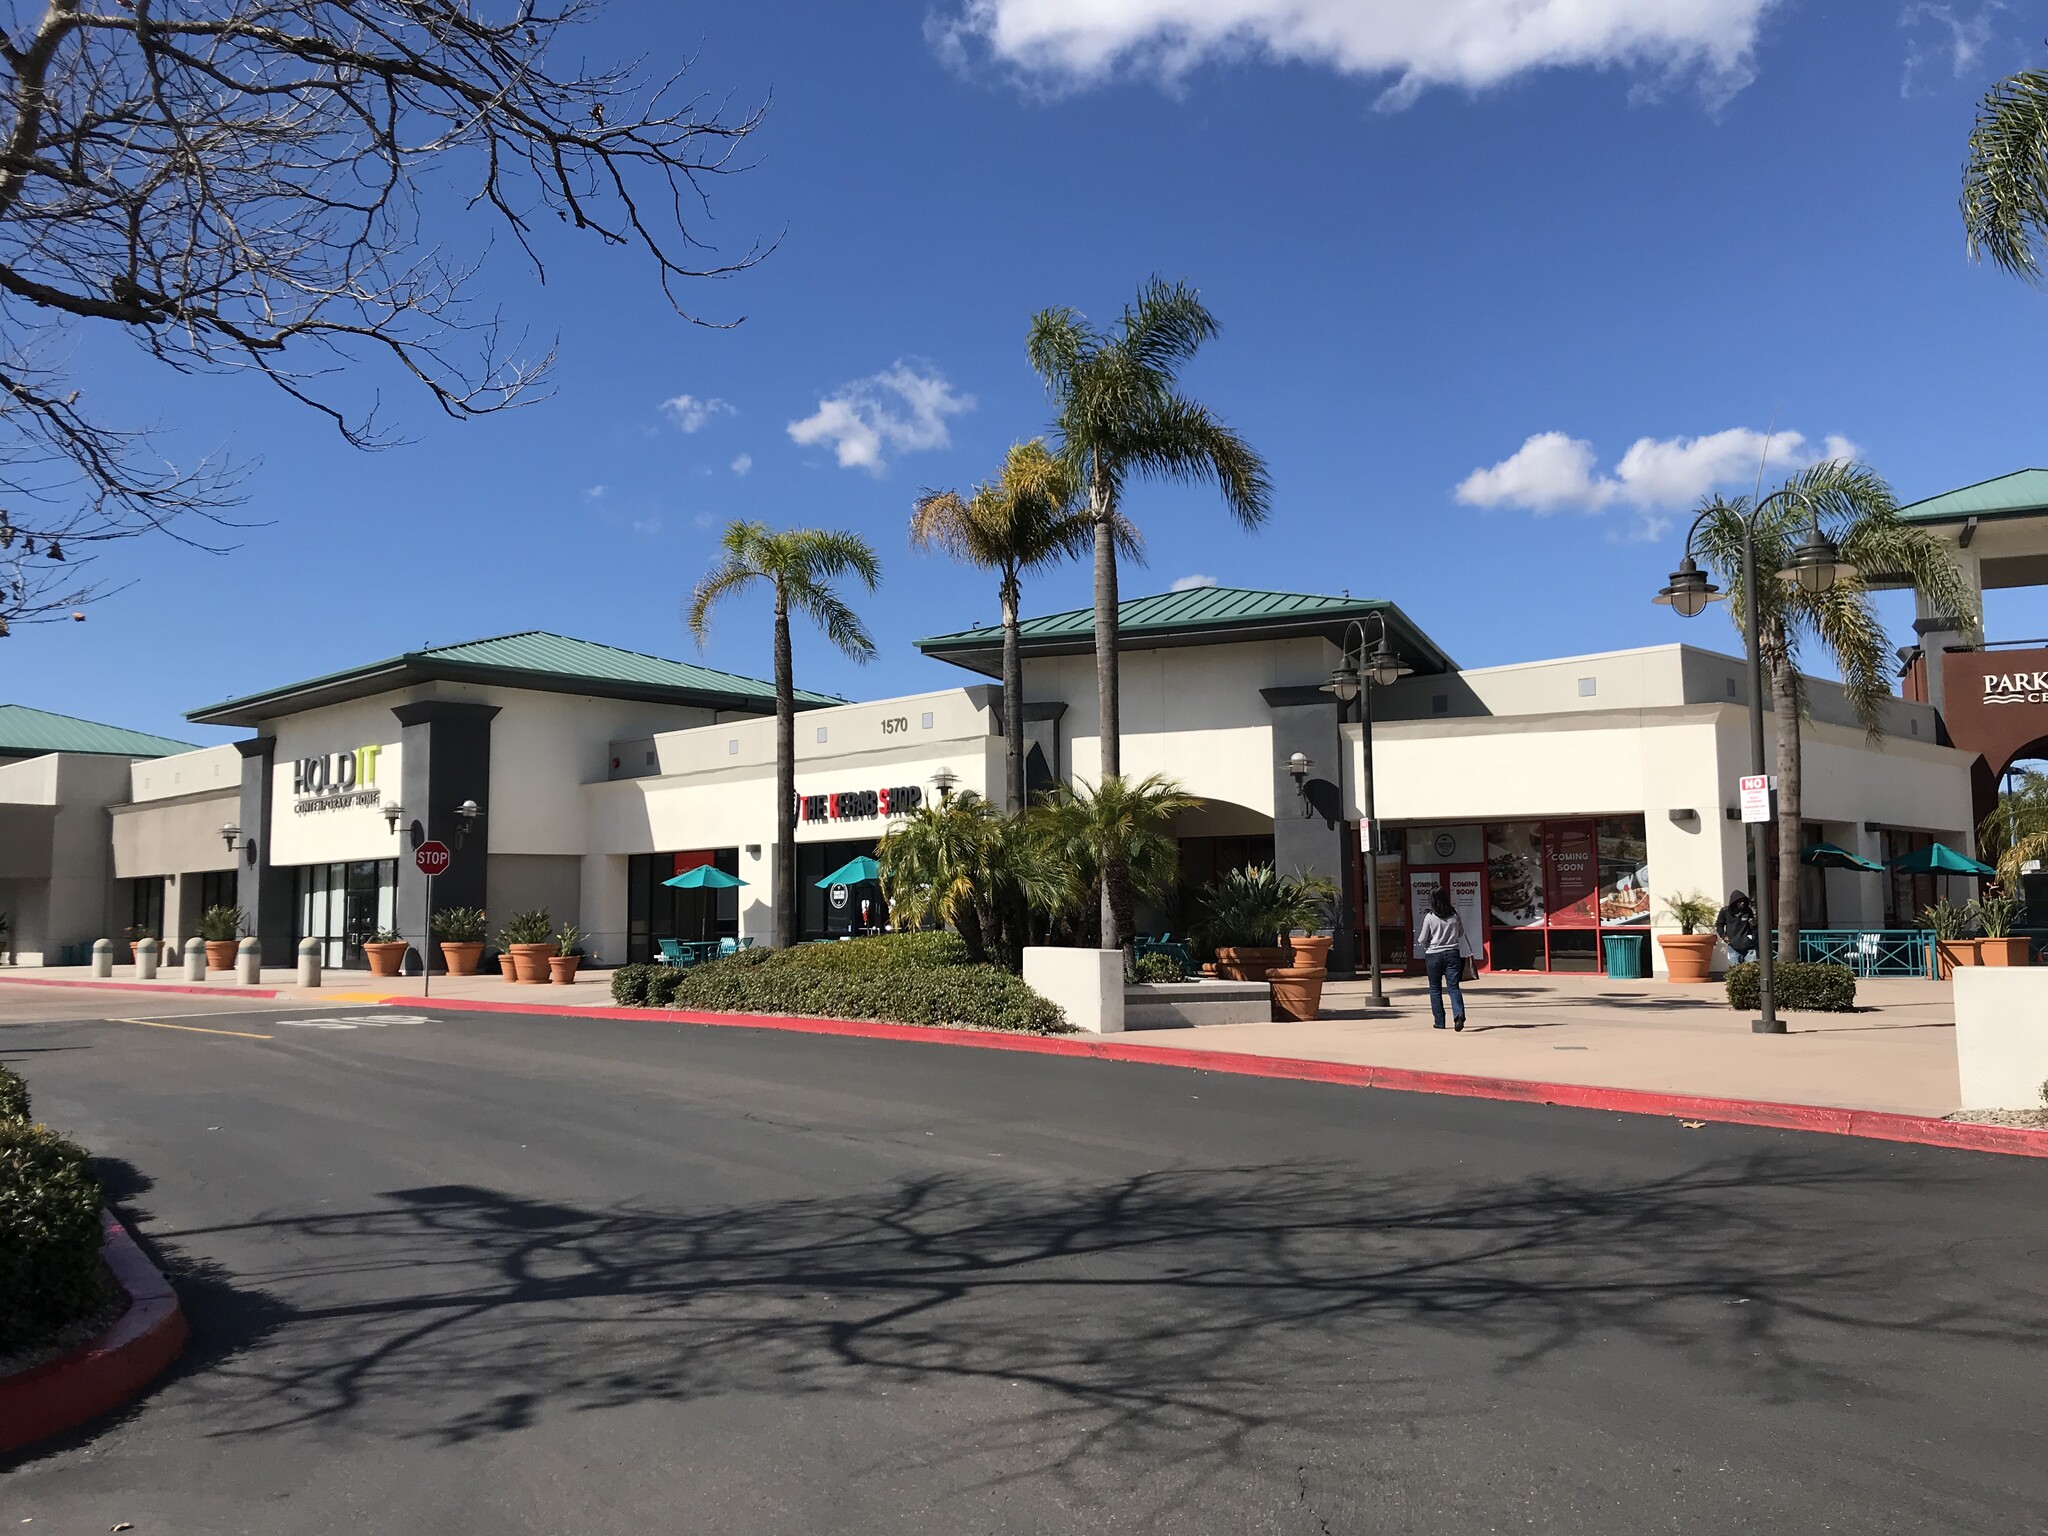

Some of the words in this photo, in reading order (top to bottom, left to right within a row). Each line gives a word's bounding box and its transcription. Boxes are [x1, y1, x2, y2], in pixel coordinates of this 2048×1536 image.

[881, 716, 908, 734] 1570
[1745, 778, 1762, 789] NO
[294, 795, 352, 814] CONTEMPORARY
[355, 793, 380, 806] HOME
[800, 794, 828, 821] THE
[829, 789, 878, 819] KEBAB
[879, 786, 921, 815] SHOP
[417, 851, 448, 865] STOP
[1551, 852, 1589, 861] COMING
[1557, 863, 1584, 871] SOON
[1452, 880, 1478, 888] COMING
